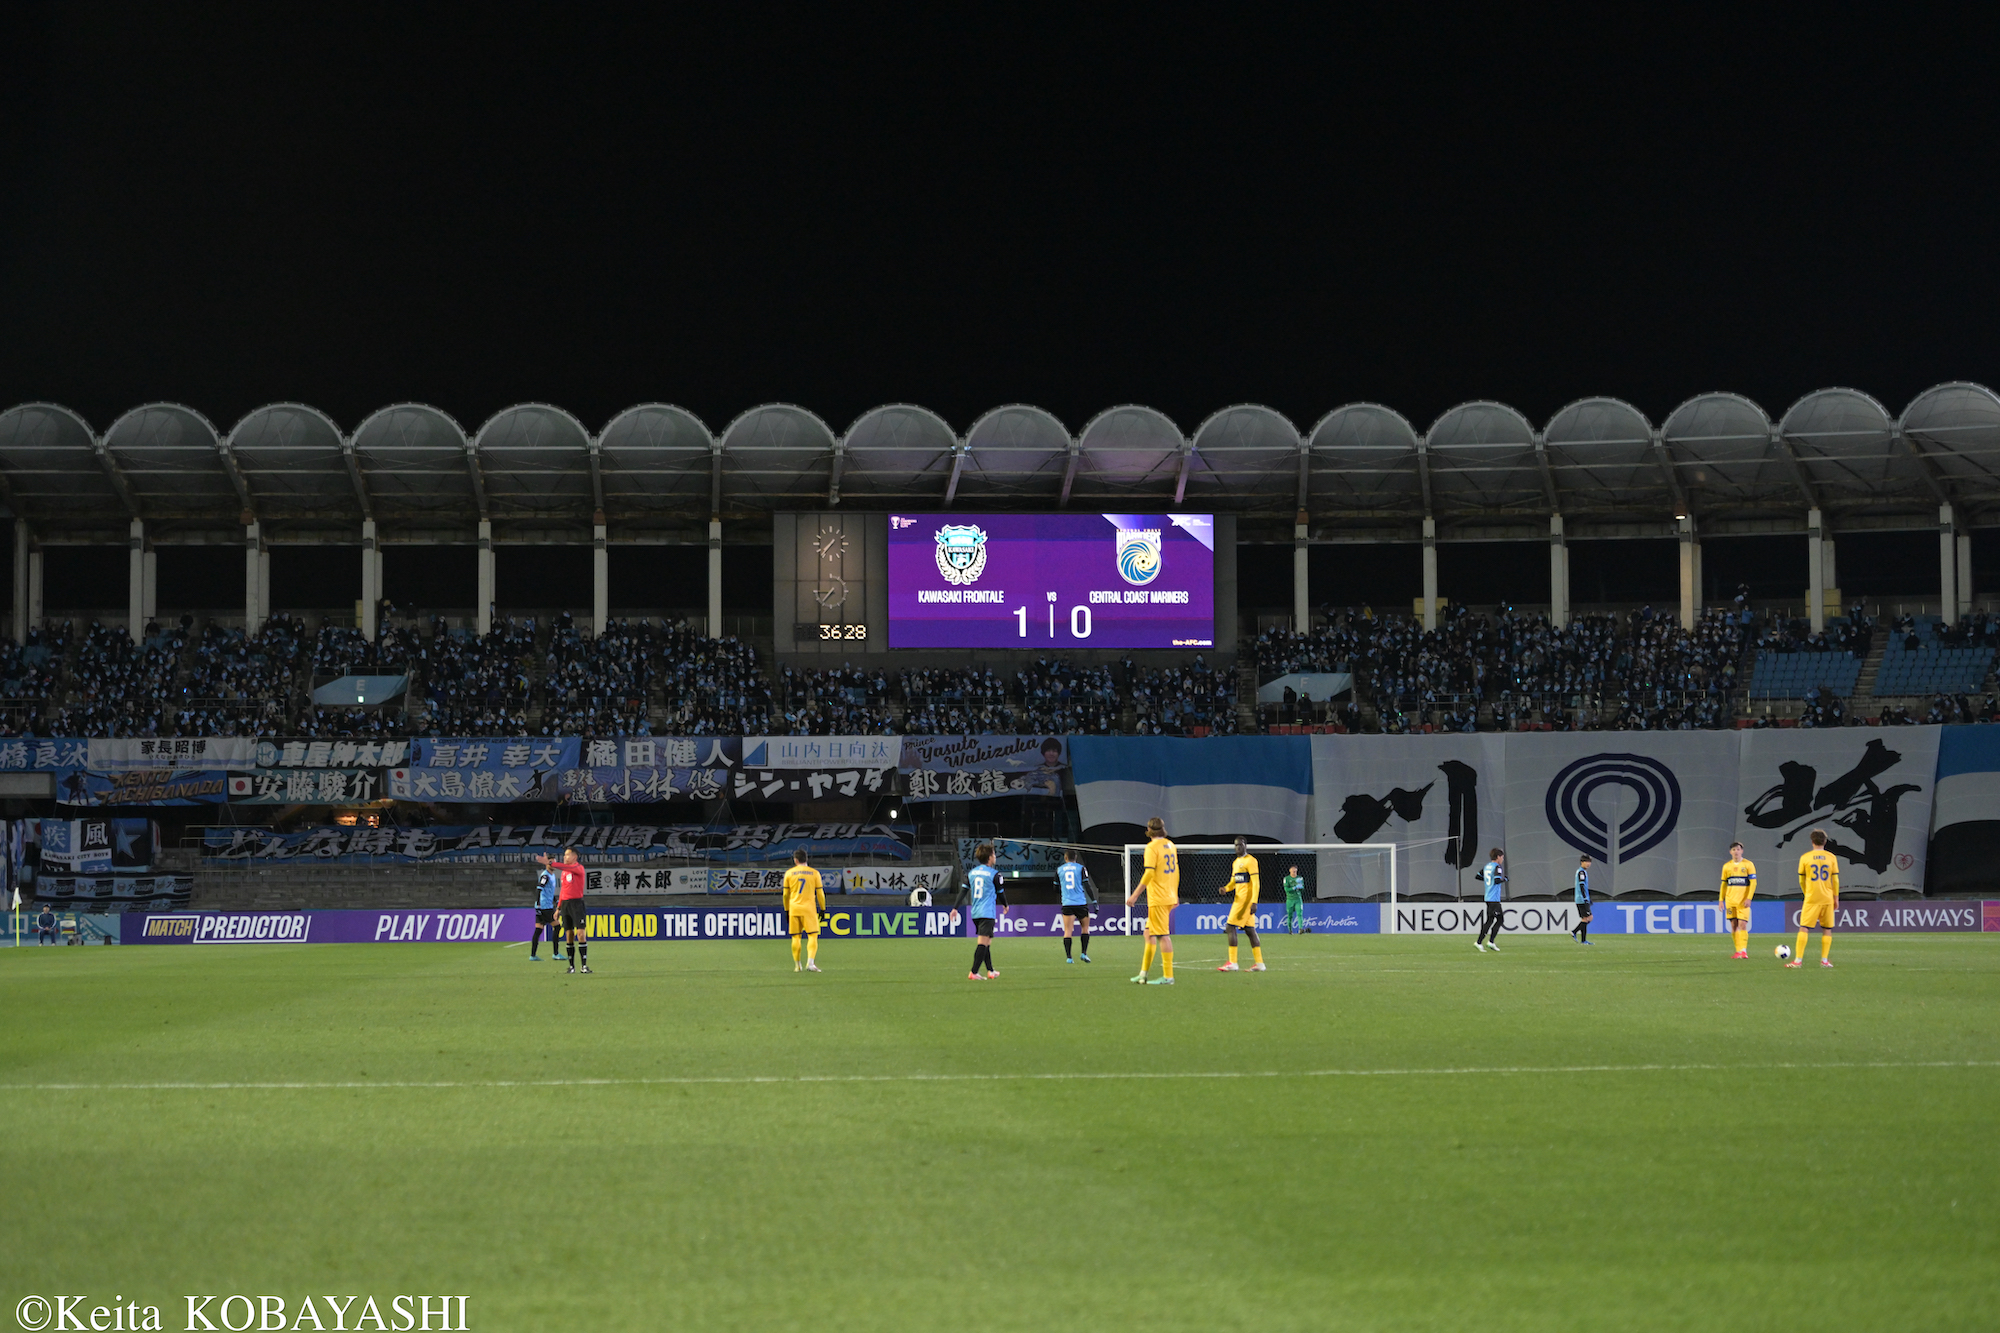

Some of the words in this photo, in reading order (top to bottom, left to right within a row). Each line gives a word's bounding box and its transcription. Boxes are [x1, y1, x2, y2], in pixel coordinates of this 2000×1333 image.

[918, 590, 962, 603] KAWASAKI
[963, 590, 1004, 603] FRONTALE
[1089, 591, 1123, 604] CENTRAL
[1123, 591, 1149, 604] COAST
[1150, 591, 1189, 604] MARINERS
[1013, 605, 1027, 638] 1
[1070, 605, 1092, 639] 0
[356, 679, 366, 691] E
[141, 740, 206, 755] 家長昭博
[782, 741, 890, 759] 山内日向汰
[903, 736, 937, 751] Prince
[918, 735, 980, 763] Yasuto
[944, 737, 1040, 769] Wakizaka
[279, 741, 409, 768] 車屋紳太郎
[429, 743, 490, 769] 高井
[502, 743, 561, 768] 幸大
[586, 739, 735, 768] 橘田健人
[108, 770, 174, 788] KENTO
[255, 769, 378, 802] 安藤駿介
[413, 770, 522, 799] 大島僚太
[94, 779, 224, 806] TACHIBANADA
[84, 821, 109, 848] 風
[44, 852, 75, 861] KAWASAKI
[580, 853, 624, 863] AMILIA
[1163, 854, 1176, 874] 33
[995, 862, 1013, 871] never
[1015, 862, 1045, 871] surrender
[1810, 864, 1829, 881] 36
[586, 870, 672, 890] 屋紳太郎
[717, 870, 785, 889] 大島僚
[798, 878, 806, 894] 7
[974, 876, 984, 898] 8
[1064, 871, 1075, 890] 9
[1484, 869, 1492, 886] 5
[148, 918, 194, 937] MATCH
[201, 915, 303, 939] PREDICTOR
[375, 915, 430, 941] PLAY
[435, 913, 504, 940] TODAY
[558, 914, 658, 938] WNLOAD
[663, 913, 698, 937] THE
[704, 912, 786, 937] OFFICIAL
[804, 912, 850, 936] FC
[856, 912, 919, 936] LIVE
[924, 912, 962, 936] APP
[1196, 914, 1272, 930] moen
[1879, 908, 1975, 927] AIRWAYS
